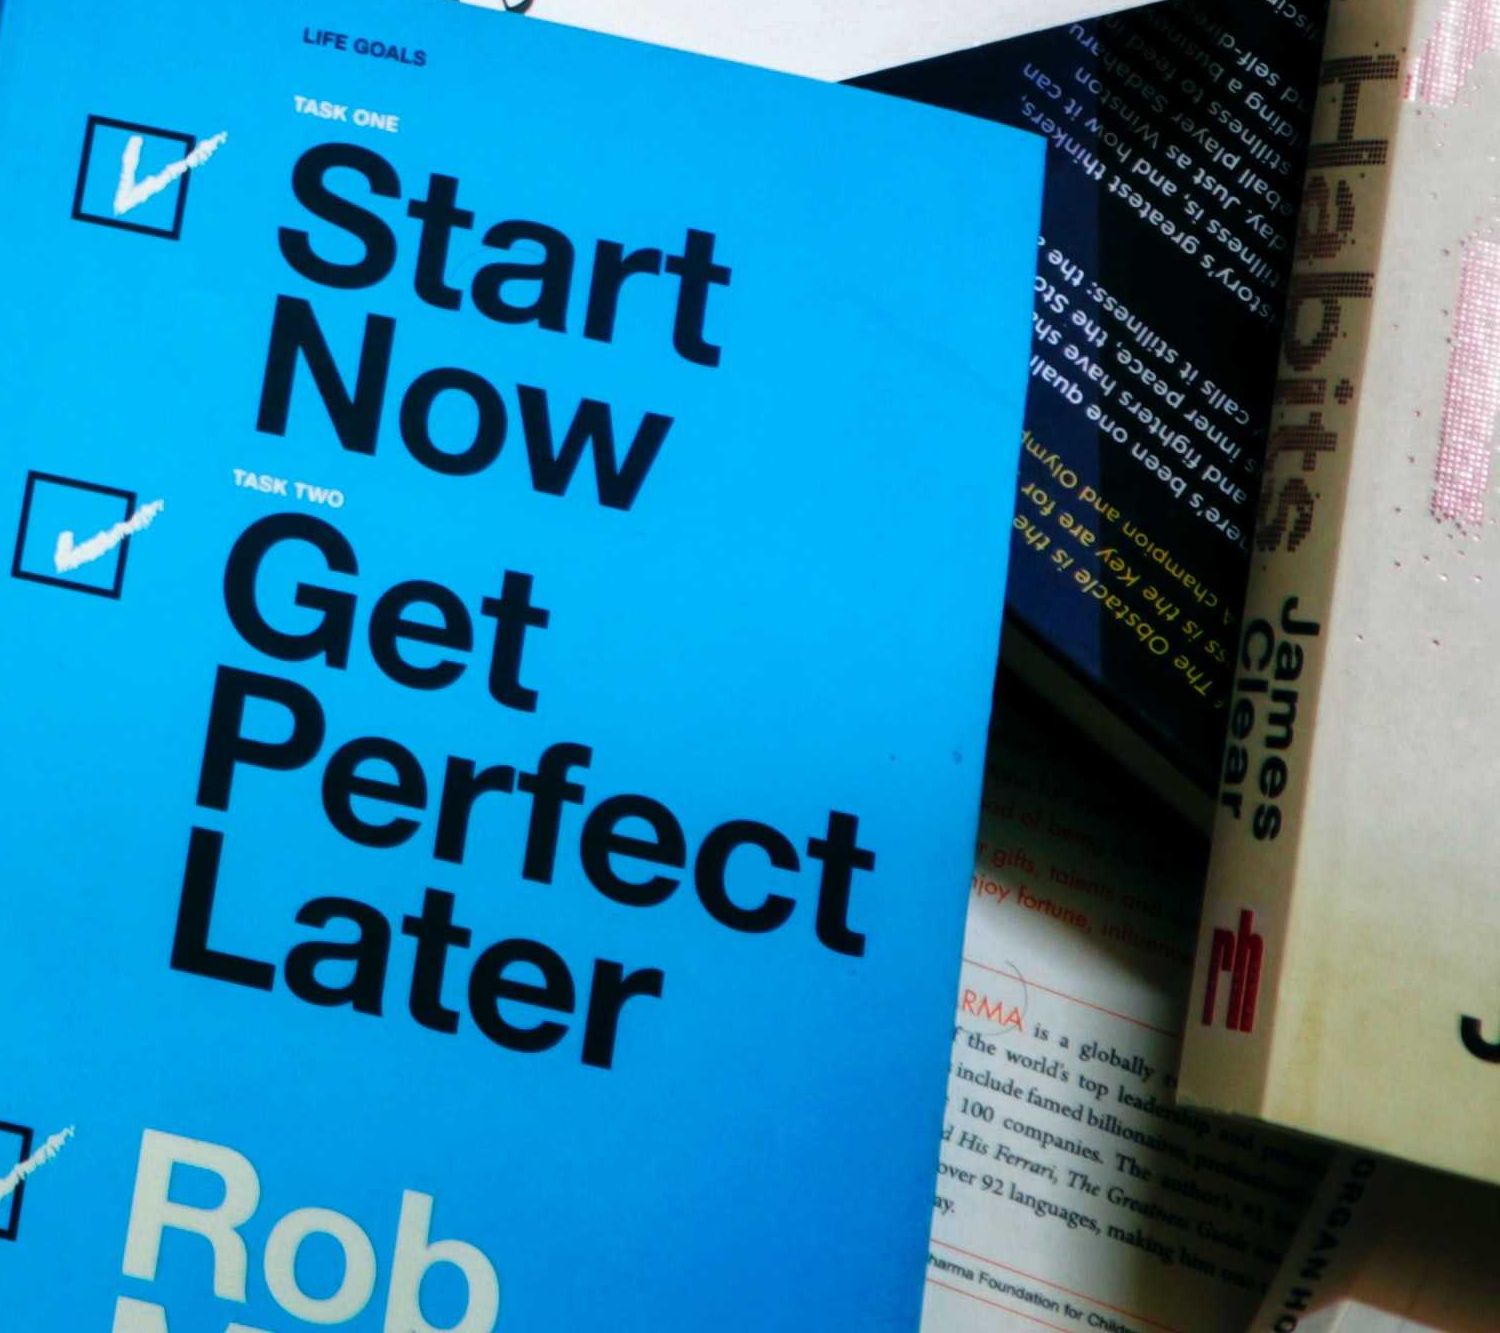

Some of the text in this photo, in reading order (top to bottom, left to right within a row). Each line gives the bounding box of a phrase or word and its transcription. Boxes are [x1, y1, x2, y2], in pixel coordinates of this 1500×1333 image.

[293, 94, 400, 134] TASK ONE
[302, 27, 429, 69] LIFE GOALS
[277, 141, 733, 369] Start
[1263, 53, 1400, 559] Habits
[232, 467, 345, 508] TASK TWO
[255, 295, 674, 512] Now
[222, 512, 550, 713] Get
[1257, 596, 1320, 839] James
[195, 664, 877, 958] Perfect
[1223, 623, 1276, 825] Clear
[170, 829, 665, 1072] Later
[122, 1128, 501, 1333] Rob
